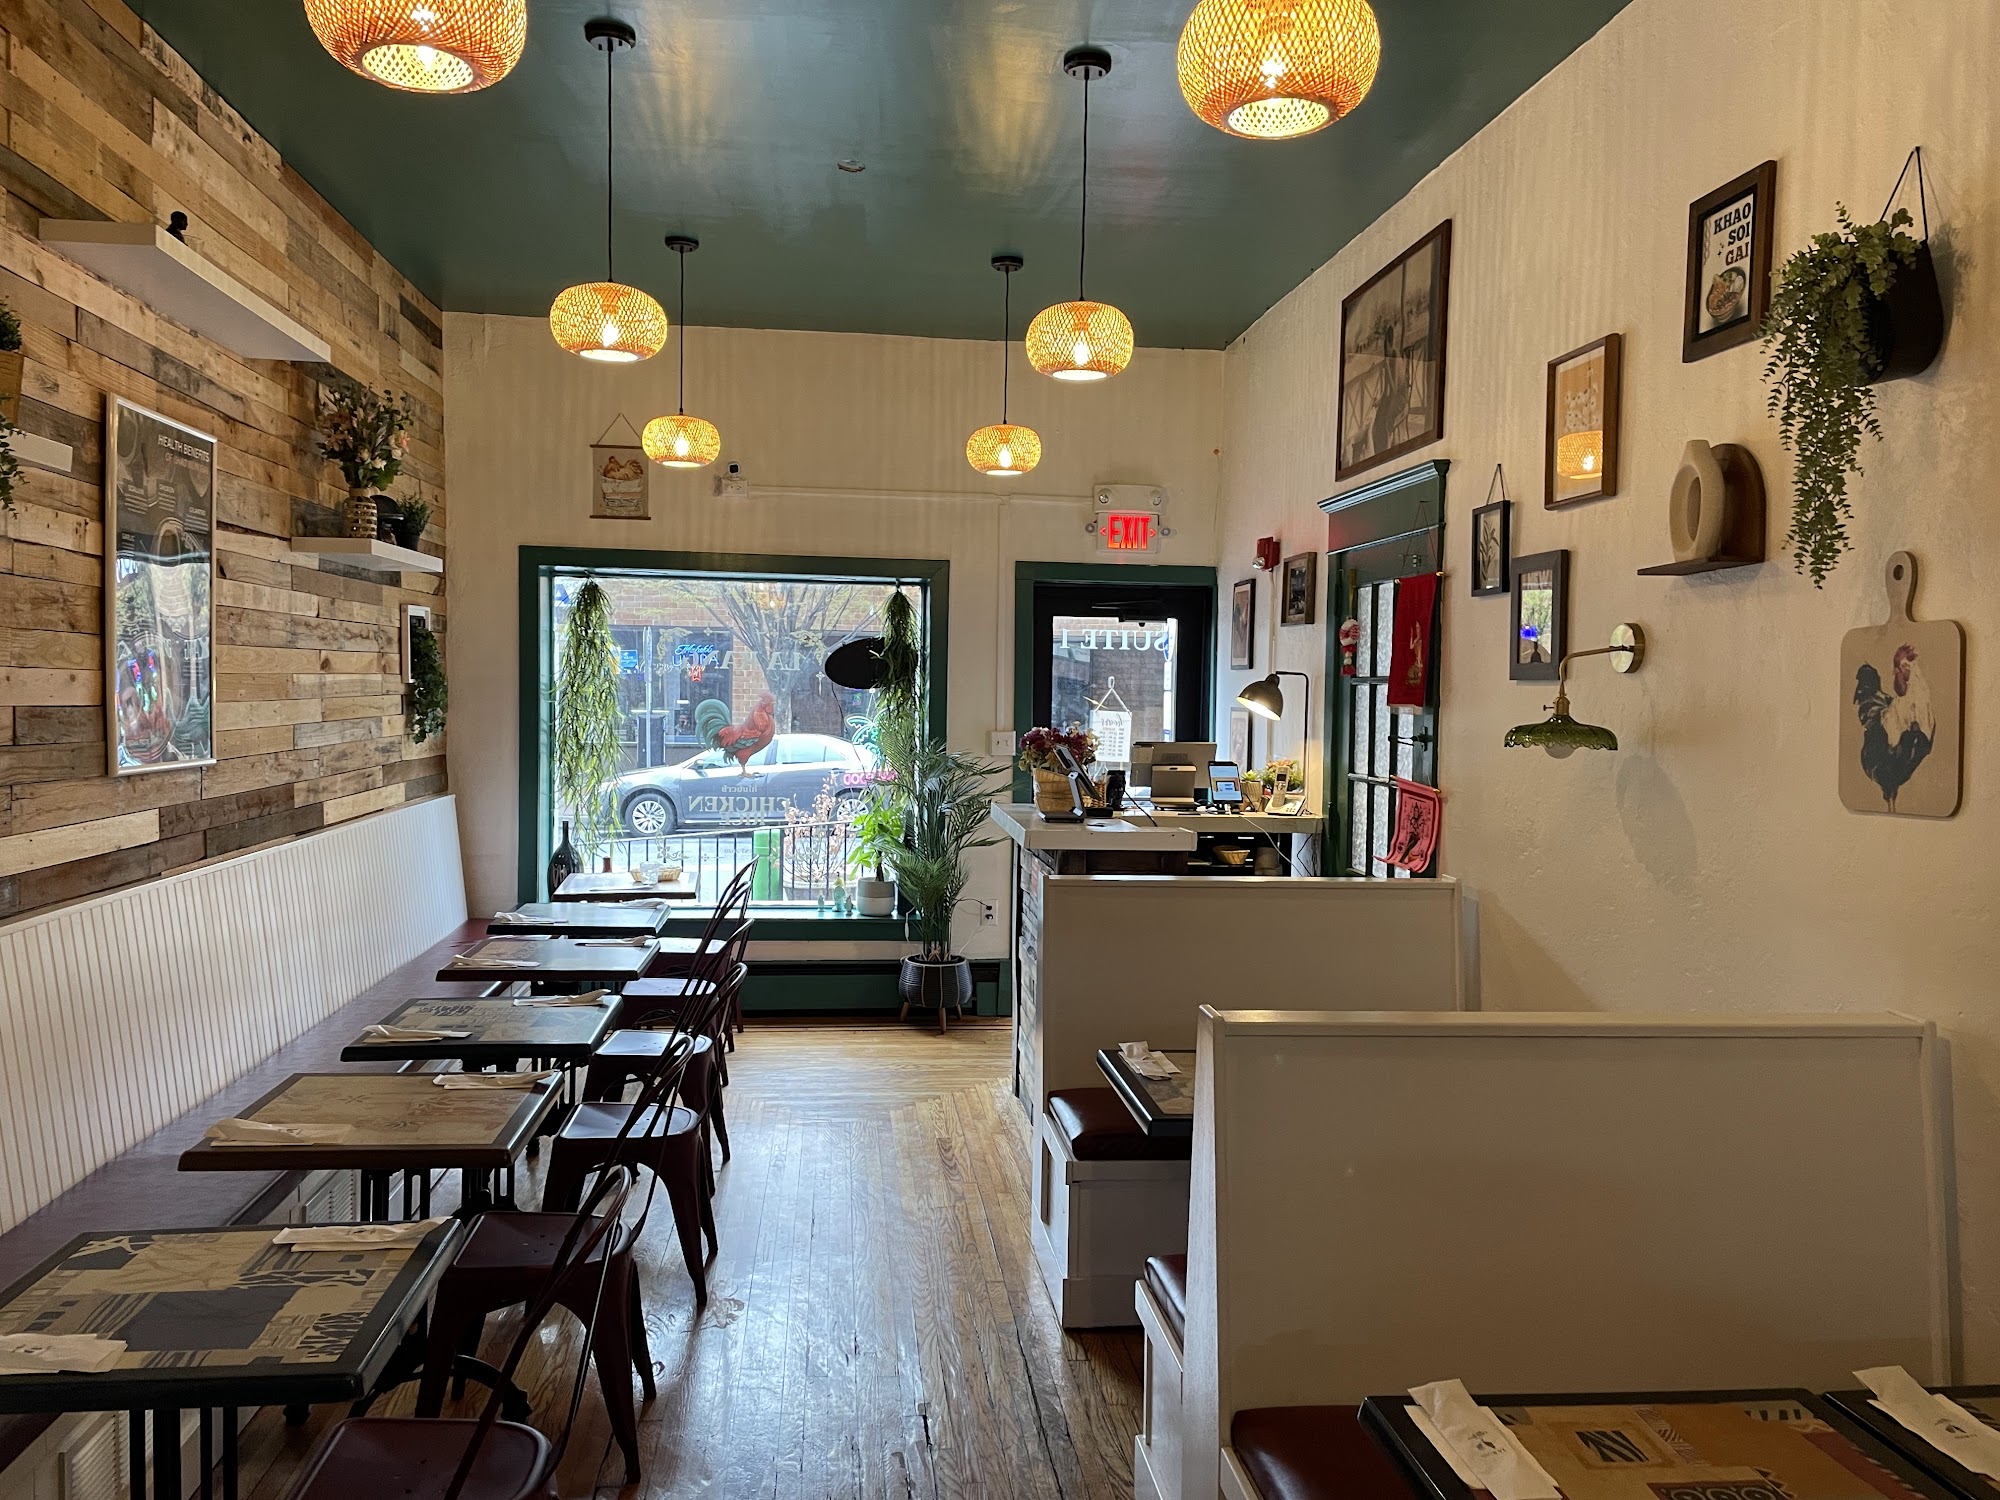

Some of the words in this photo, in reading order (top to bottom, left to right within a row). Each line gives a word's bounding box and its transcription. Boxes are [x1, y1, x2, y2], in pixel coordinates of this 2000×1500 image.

[1714, 203, 1751, 234] KHAO
[1728, 221, 1750, 246] SOI
[1725, 241, 1750, 266] GAI
[158, 434, 183, 455] HEALTH
[183, 443, 210, 462] BENEFITS
[1108, 514, 1151, 549] EXIT
